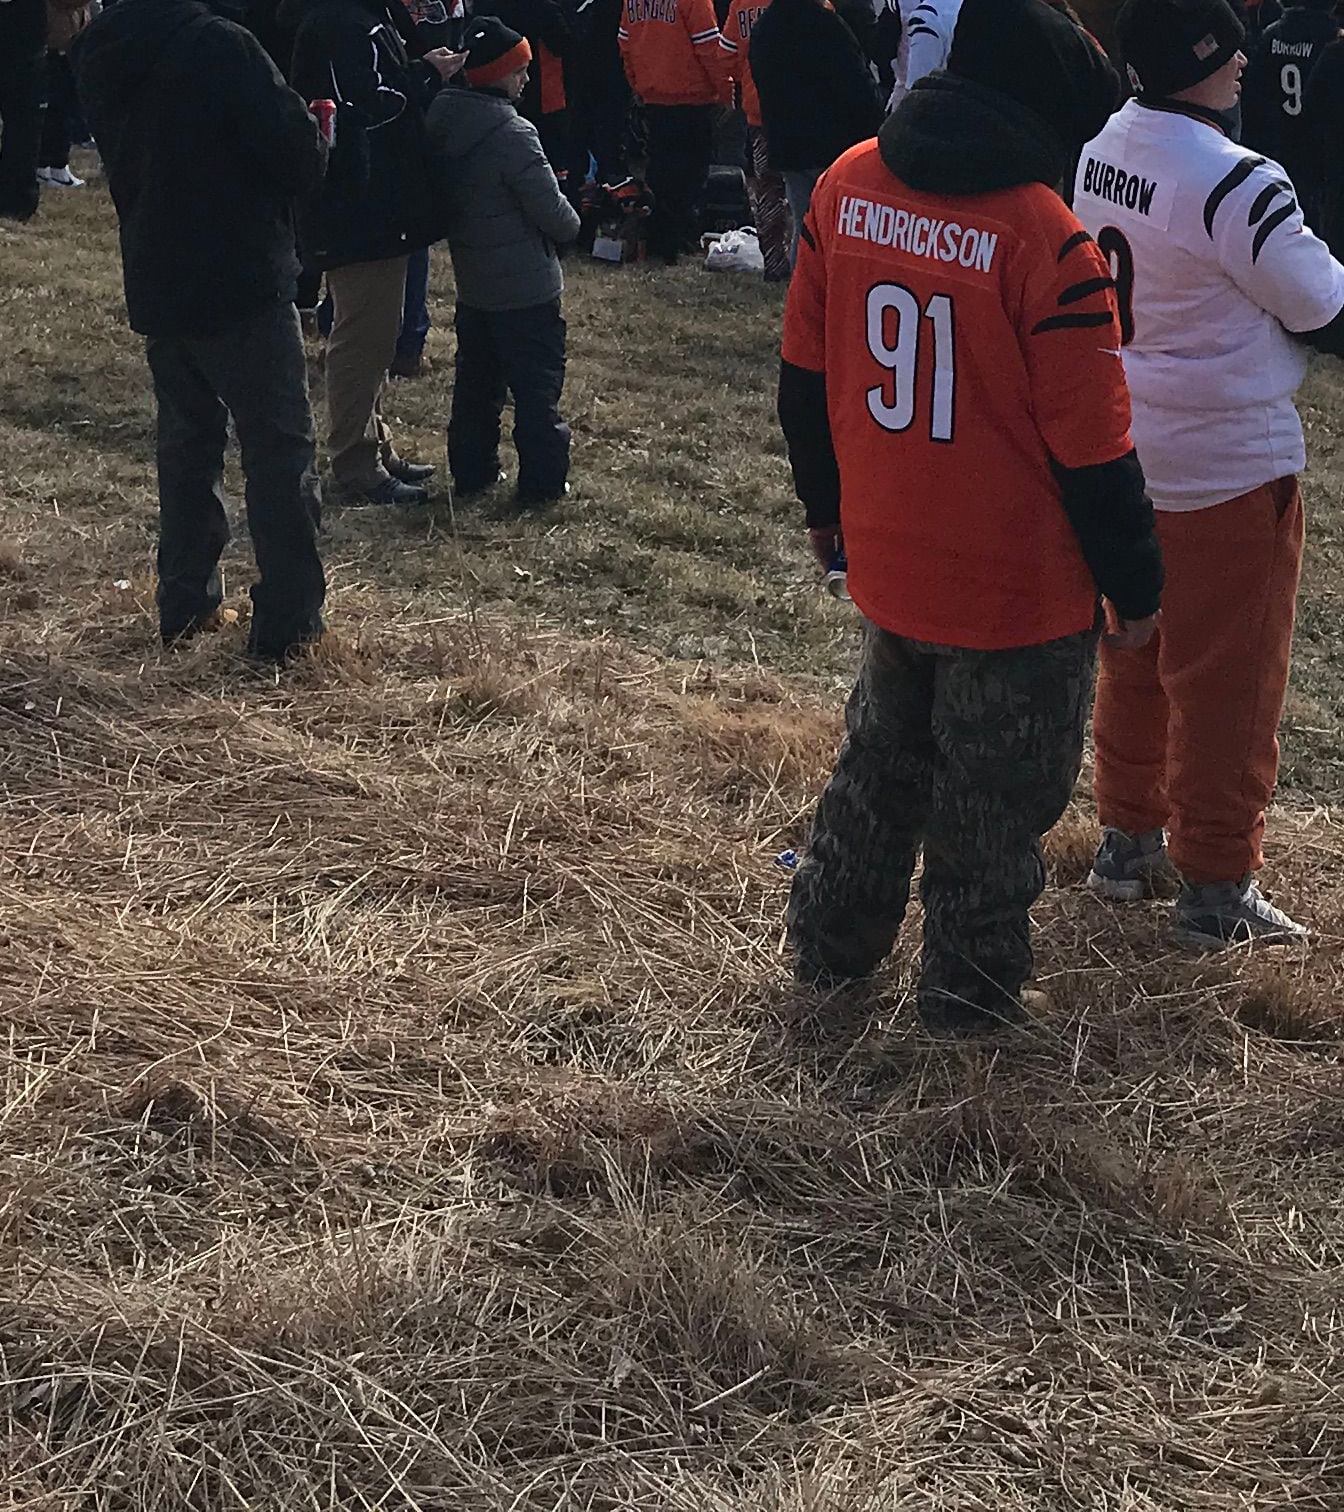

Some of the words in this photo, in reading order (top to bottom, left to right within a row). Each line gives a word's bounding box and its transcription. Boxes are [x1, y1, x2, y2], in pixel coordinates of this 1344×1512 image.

[1271, 38, 1314, 58] BURROW
[1280, 63, 1302, 117] 9
[1083, 156, 1158, 216] BURROW
[837, 196, 998, 273] HENDRICKSON
[864, 280, 955, 443] 91
